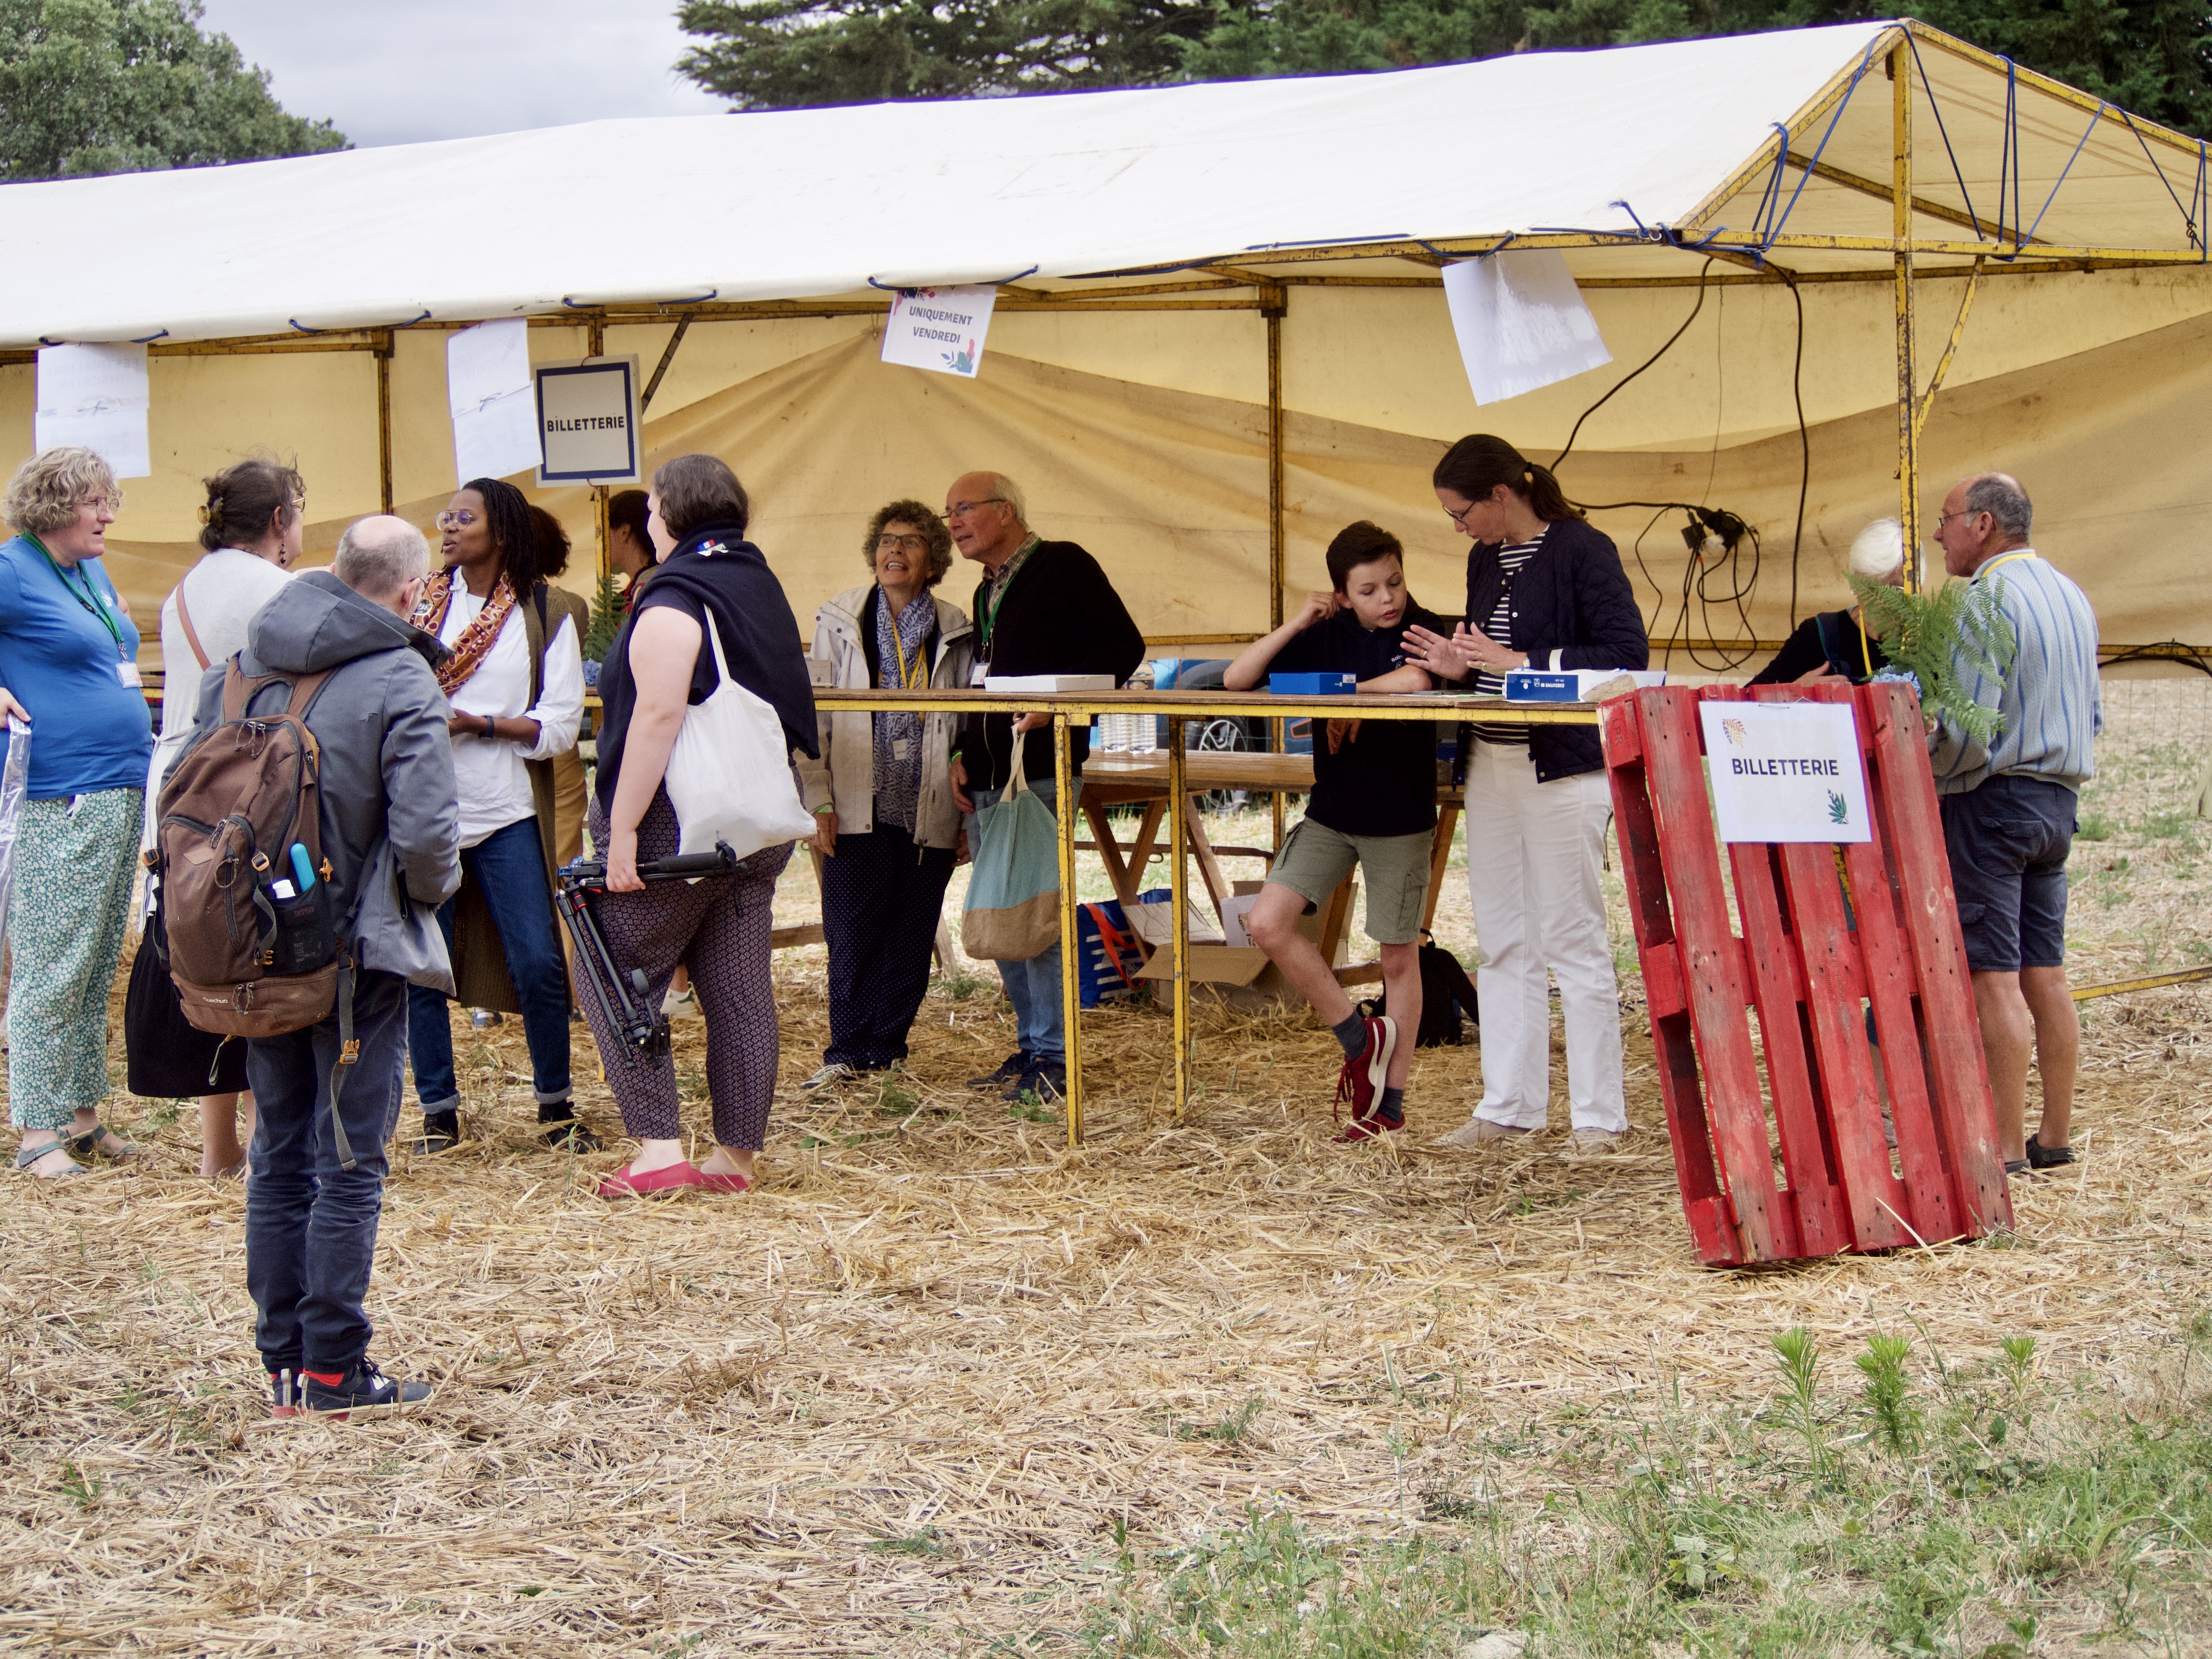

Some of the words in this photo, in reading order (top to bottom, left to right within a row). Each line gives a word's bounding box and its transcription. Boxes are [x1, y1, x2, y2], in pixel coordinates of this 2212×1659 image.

[909, 306, 973, 326] UNIQUEMENT
[913, 326, 961, 344] VENDREDI
[547, 415, 625, 432] BILLETTERIE
[1731, 758, 1839, 776] BILLETTERIE
